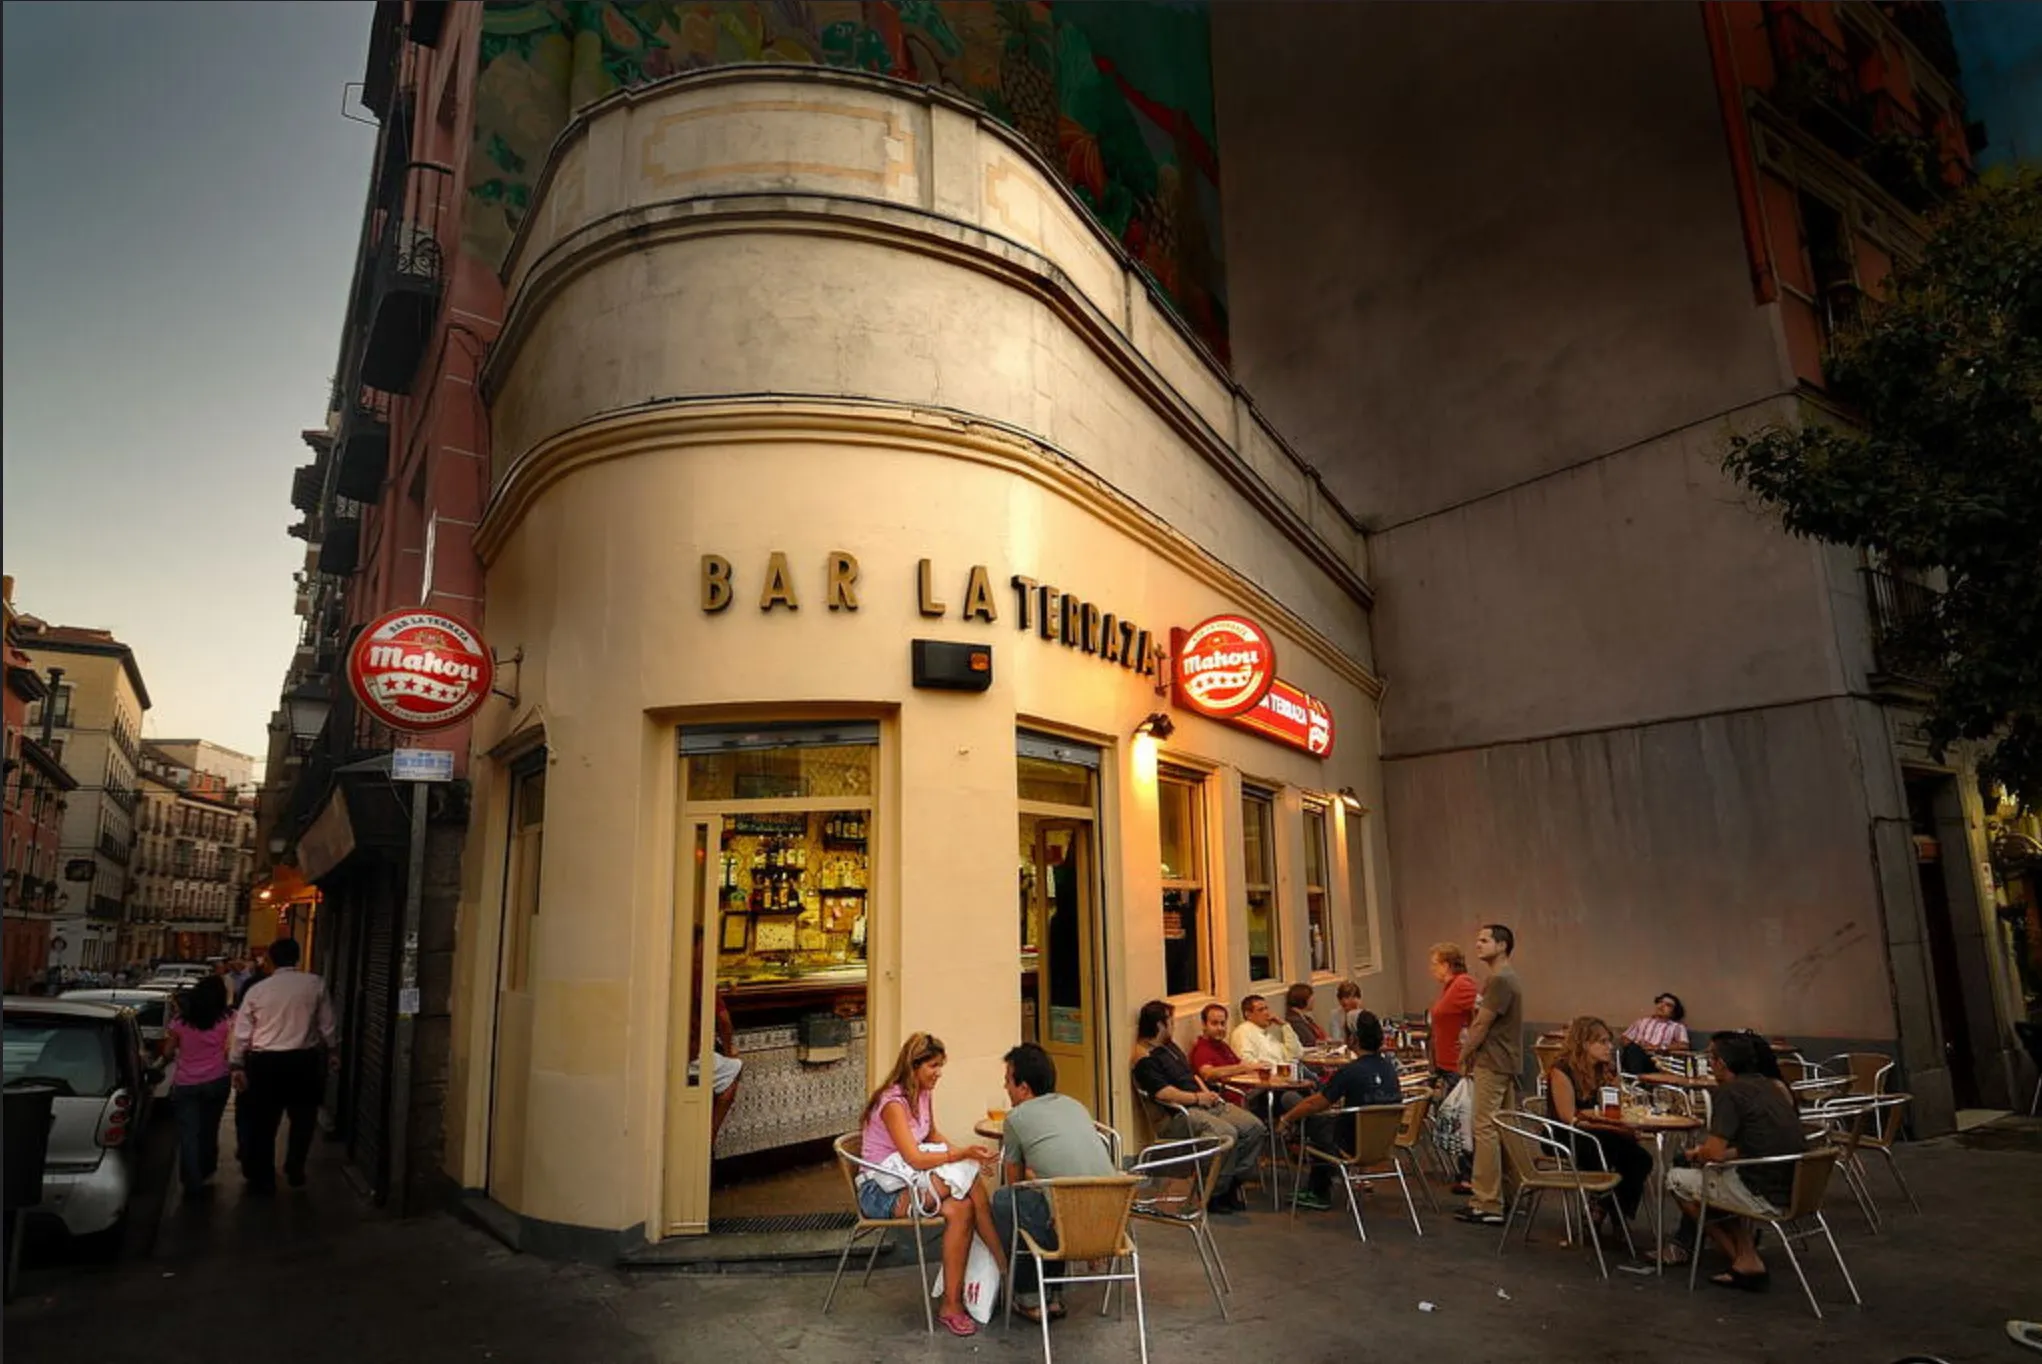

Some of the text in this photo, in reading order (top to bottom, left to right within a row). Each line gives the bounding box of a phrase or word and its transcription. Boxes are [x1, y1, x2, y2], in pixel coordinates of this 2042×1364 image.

[700, 550, 1155, 676] BAR LA TERRAZA
[369, 645, 479, 682] Mahou
[1183, 649, 1260, 675] Mahou
